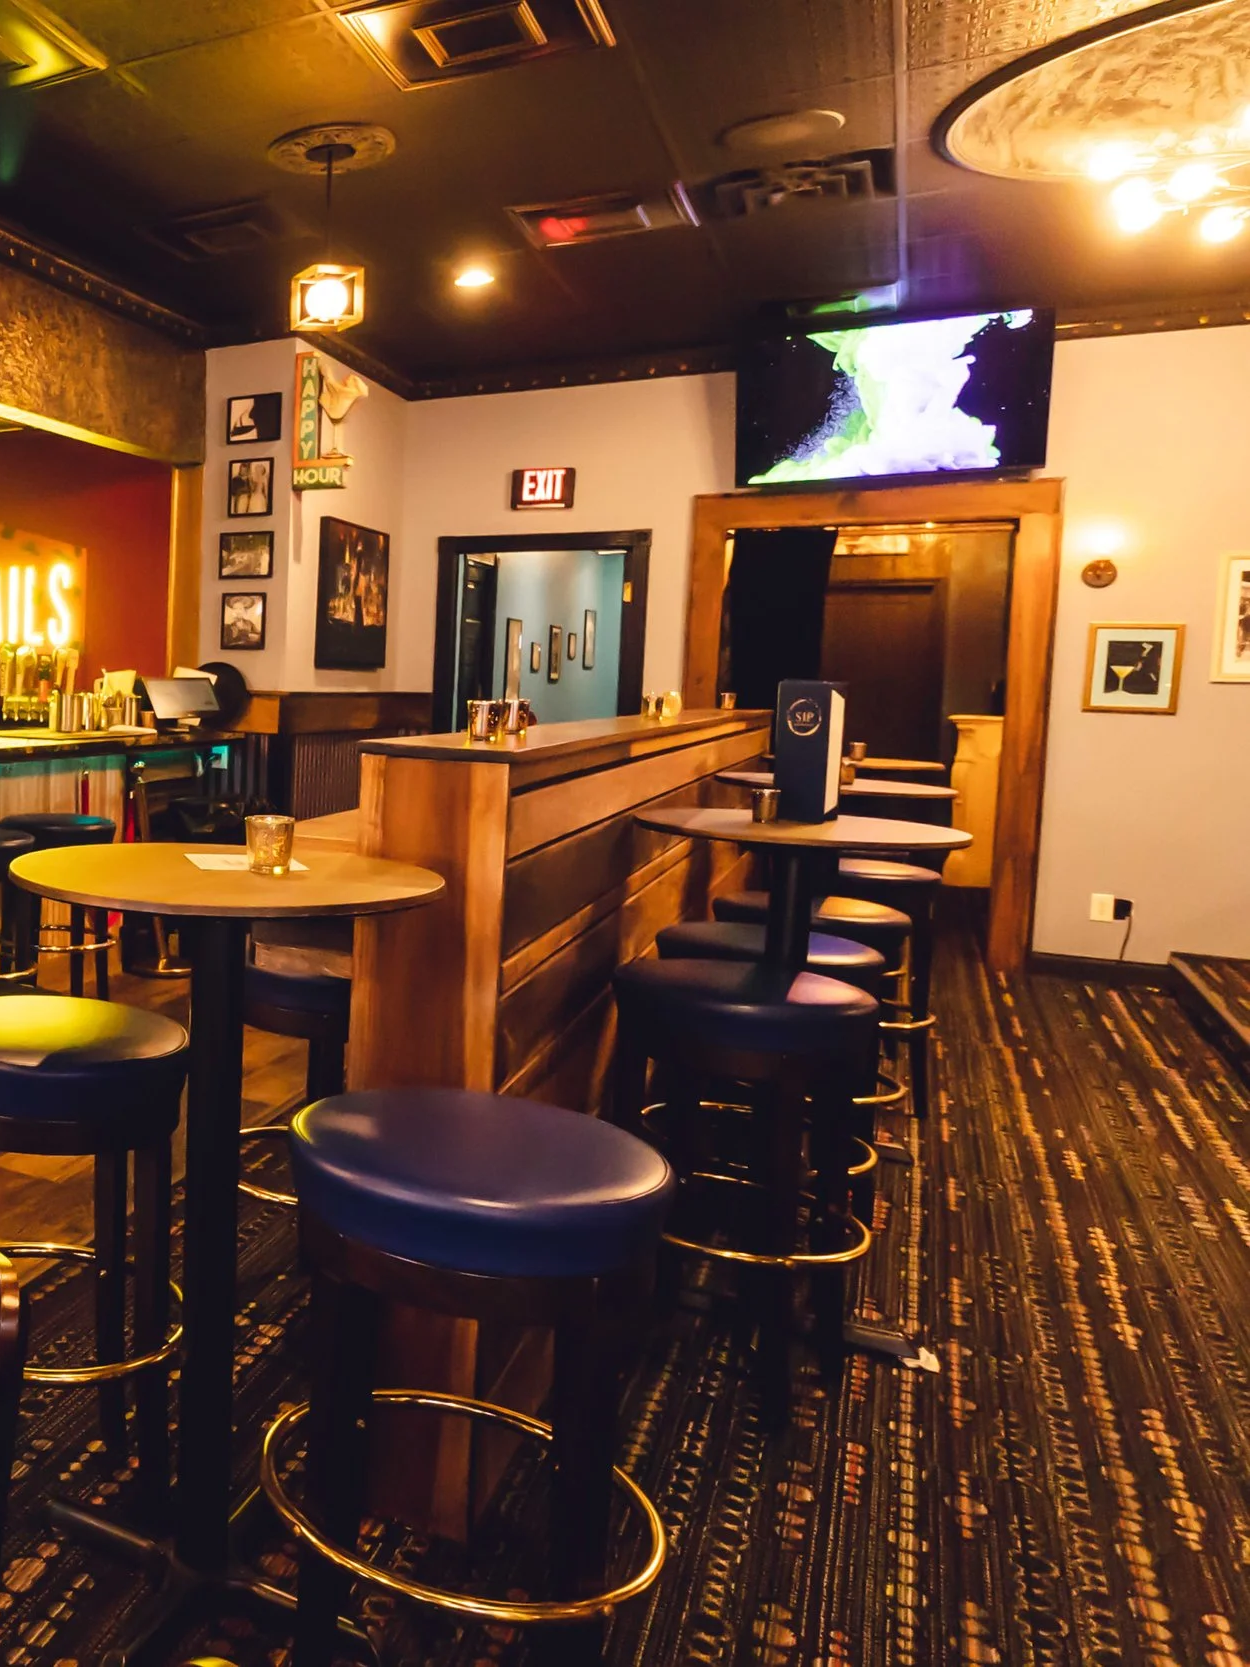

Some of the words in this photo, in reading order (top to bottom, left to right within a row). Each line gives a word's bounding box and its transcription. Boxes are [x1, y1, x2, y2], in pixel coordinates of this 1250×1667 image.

[300, 358, 316, 459] HAPPY
[293, 467, 341, 485] HOUR
[522, 469, 566, 501] EXIT
[795, 712, 814, 722] SIP
